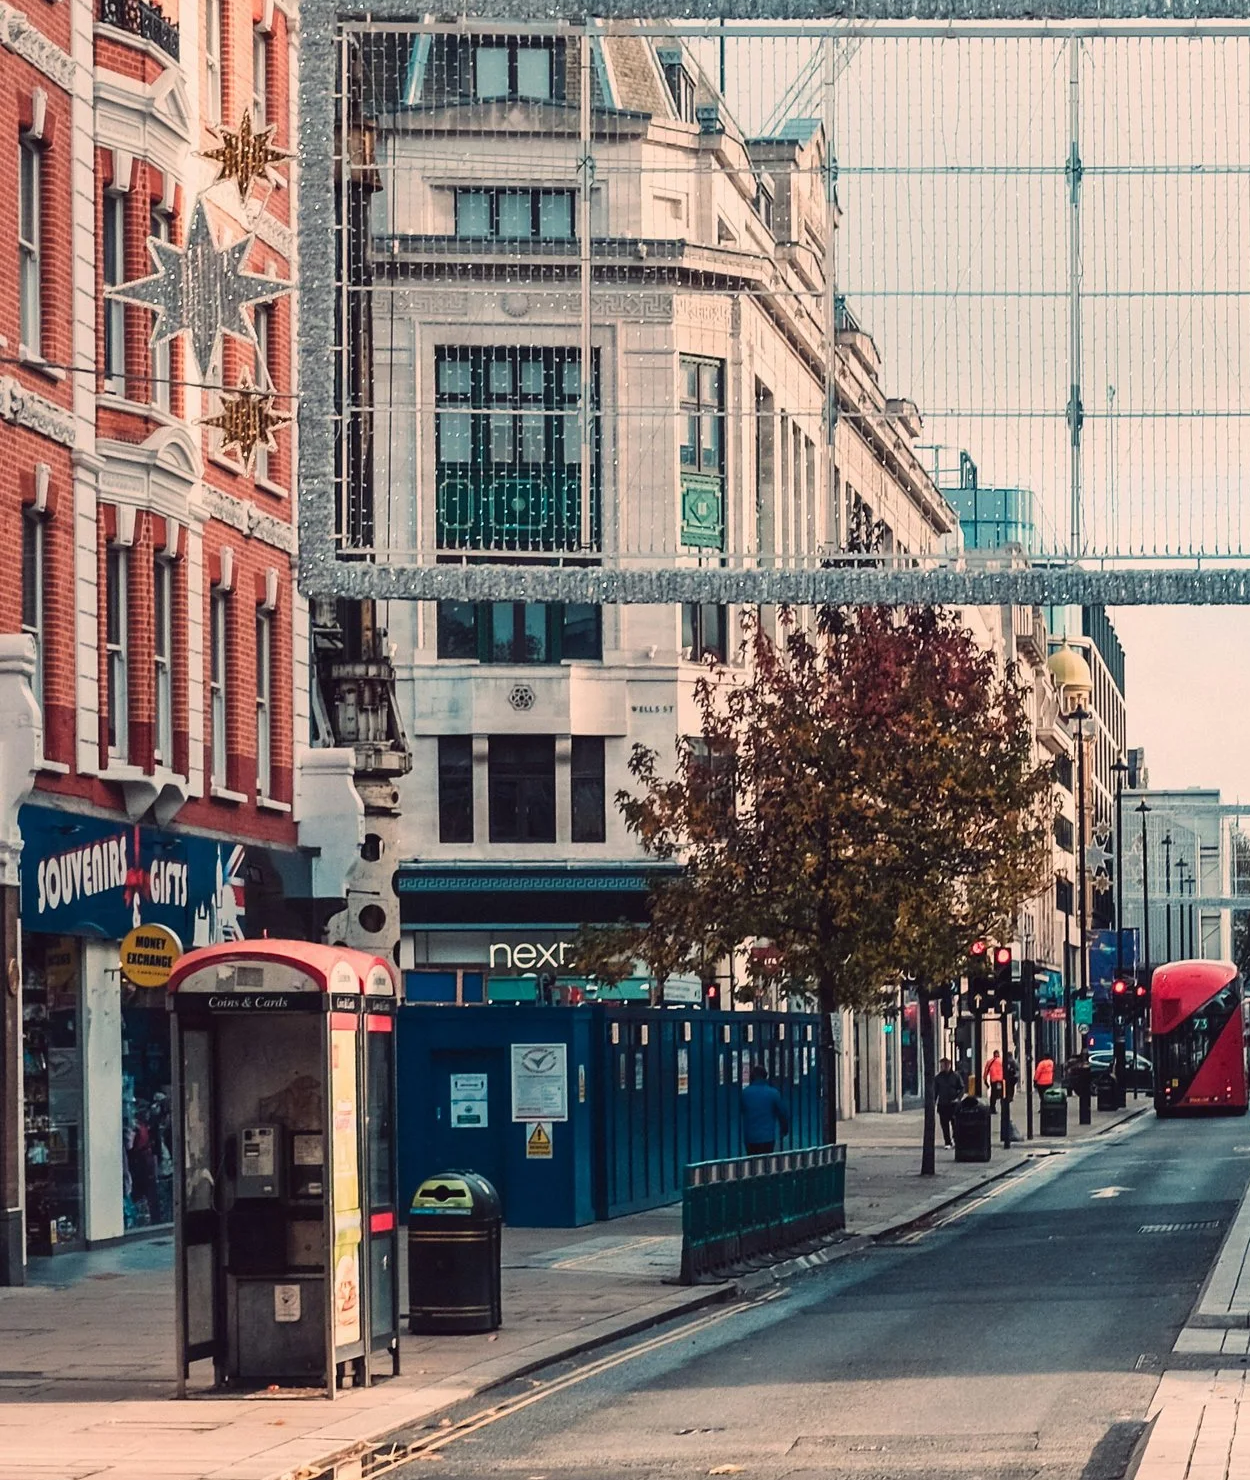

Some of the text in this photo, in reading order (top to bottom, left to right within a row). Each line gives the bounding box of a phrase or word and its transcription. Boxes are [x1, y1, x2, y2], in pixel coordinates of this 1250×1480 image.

[631, 705, 674, 713] WELLS ST
[38, 836, 127, 914] SOUVENIRS
[150, 859, 187, 907] GIFTS
[136, 936, 167, 950] MONEY
[127, 952, 173, 968] EXCHANGE
[208, 997, 289, 1008] Coins & Cards
[1193, 1019, 1208, 1030] 73
